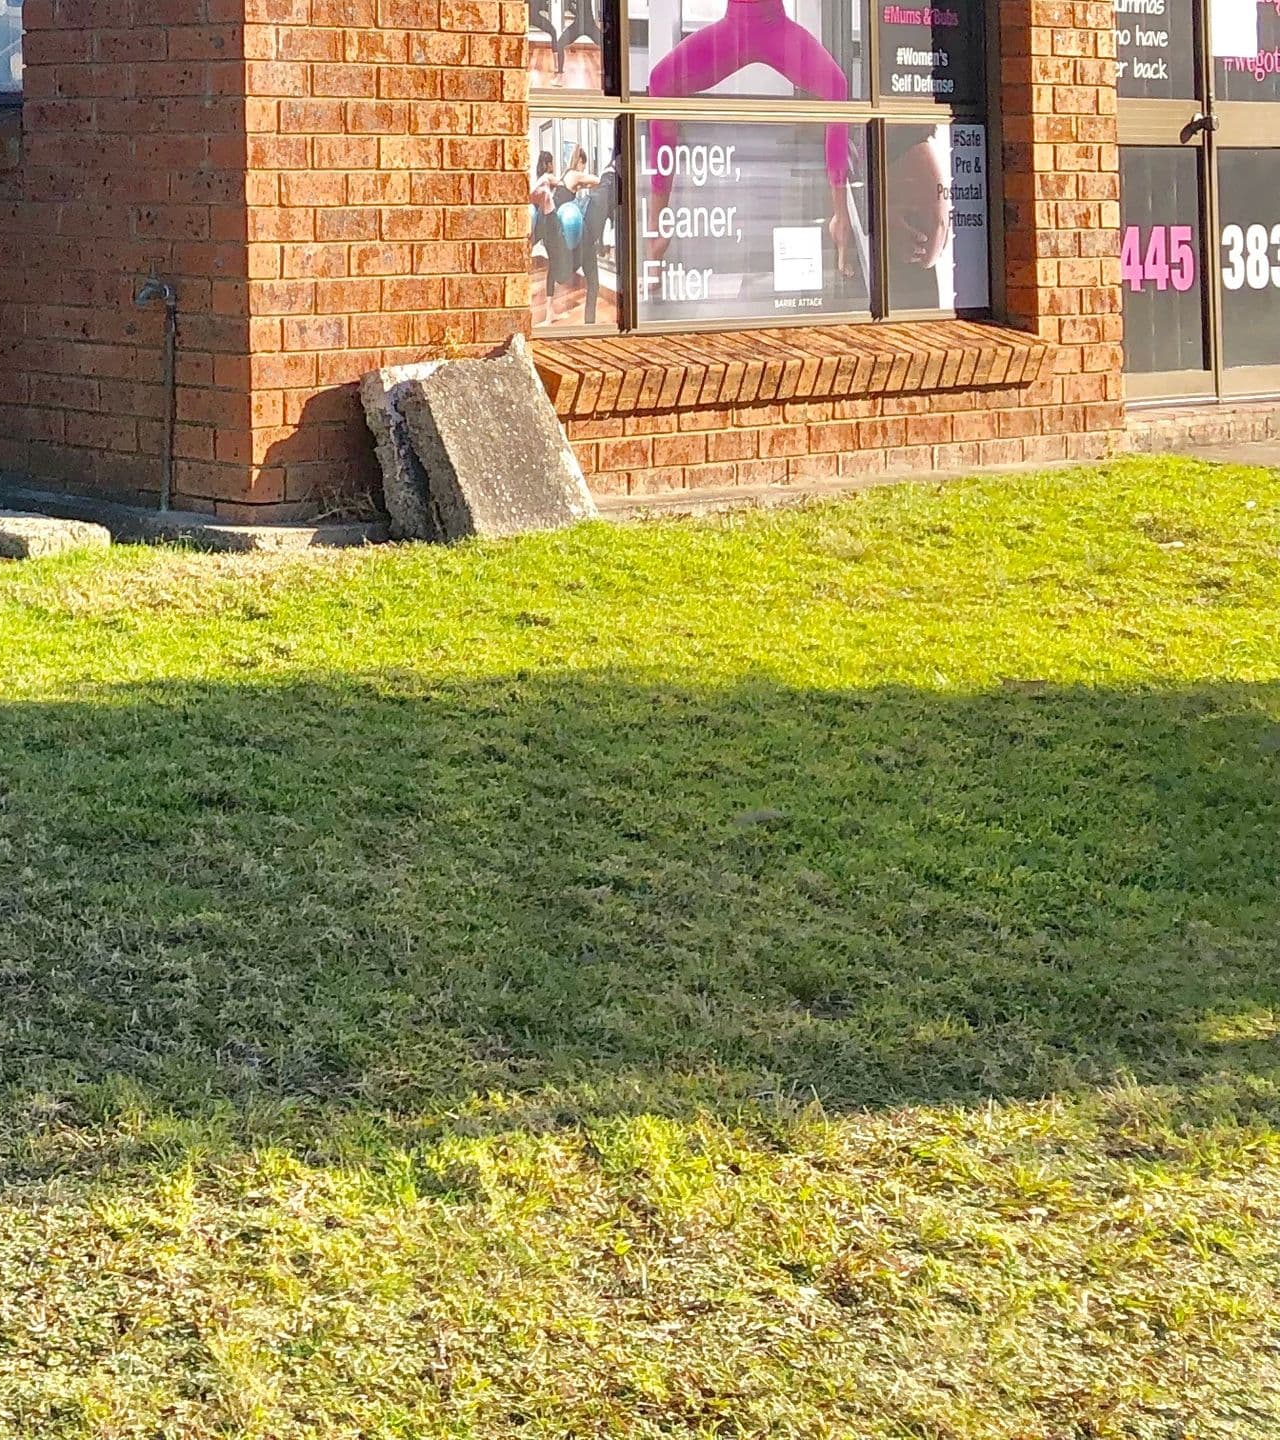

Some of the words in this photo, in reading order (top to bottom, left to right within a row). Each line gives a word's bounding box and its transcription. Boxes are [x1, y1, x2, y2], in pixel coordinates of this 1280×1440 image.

[884, 6, 921, 25] #Mums
[923, 8, 932, 25] &
[1135, 24, 1169, 47] have
[896, 47, 949, 67] #Women's
[1133, 57, 1168, 79] back
[892, 73, 912, 93] Self
[953, 130, 981, 147] #Safe
[640, 134, 740, 187] Longer,
[955, 157, 971, 173] Pre
[974, 157, 982, 173] &
[937, 184, 983, 200] Postnatal
[641, 197, 742, 243] Leaner,
[948, 211, 984, 227] Fitness
[642, 260, 713, 301] Fitter
